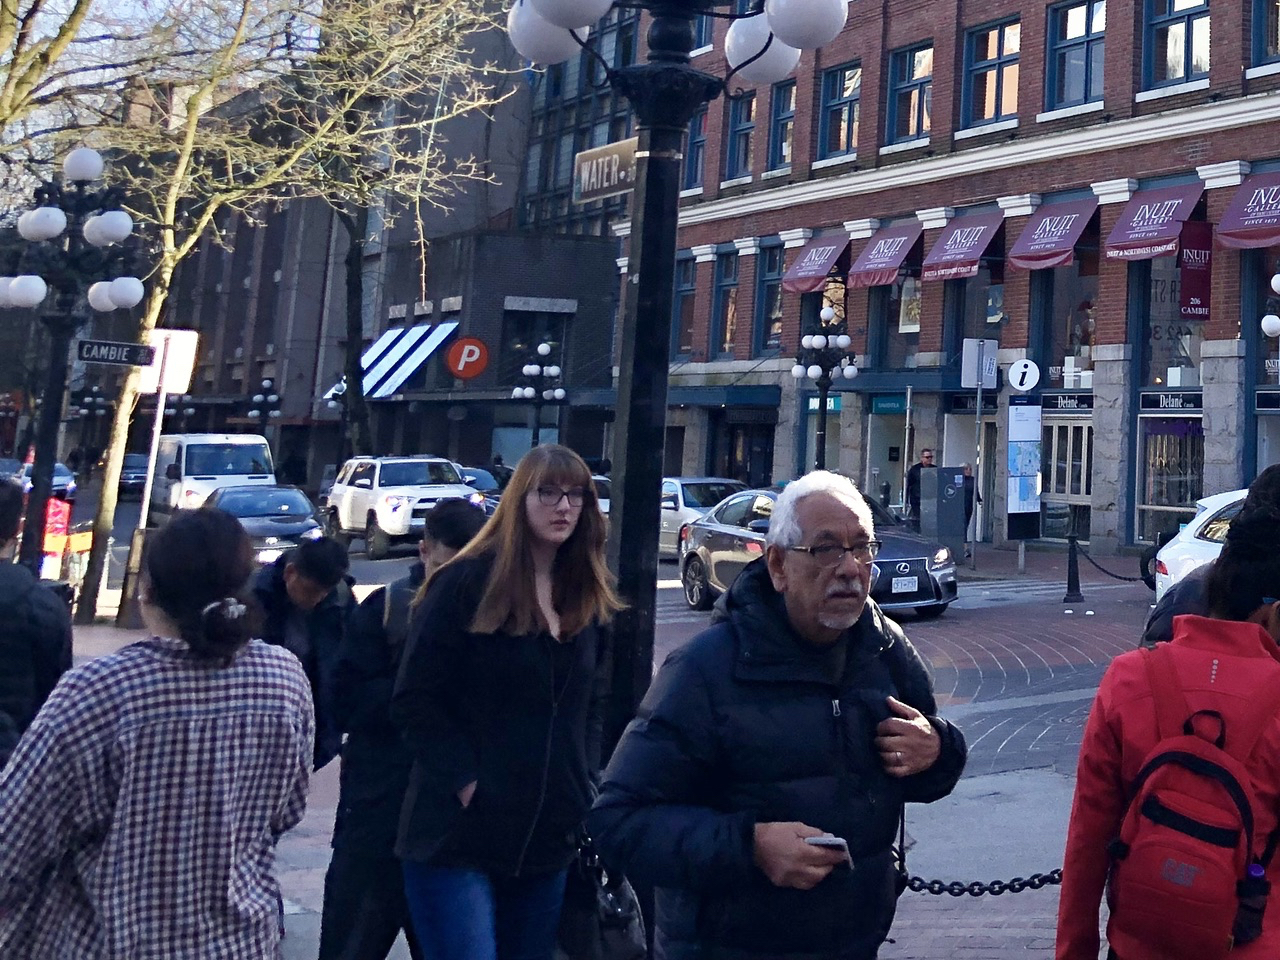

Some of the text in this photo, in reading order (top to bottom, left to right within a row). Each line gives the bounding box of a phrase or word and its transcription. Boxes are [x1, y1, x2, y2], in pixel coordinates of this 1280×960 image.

[581, 154, 620, 193] WATER
[1133, 198, 1183, 221] INUIT
[1035, 214, 1079, 234] INUIT
[1132, 217, 1170, 227] GALLERY
[947, 225, 988, 244] INUIT
[1032, 230, 1069, 239] GALLERY
[871, 237, 907, 253] INUIT
[804, 245, 836, 262] INUIT
[1183, 248, 1211, 261] INUIT
[1190, 297, 1201, 305] 206
[1181, 307, 1209, 315] CAMBIE
[82, 344, 130, 361] CAMBIE
[457, 345, 480, 371] P
[1058, 394, 1079, 409] Delané
[1160, 393, 1183, 408] Delané
